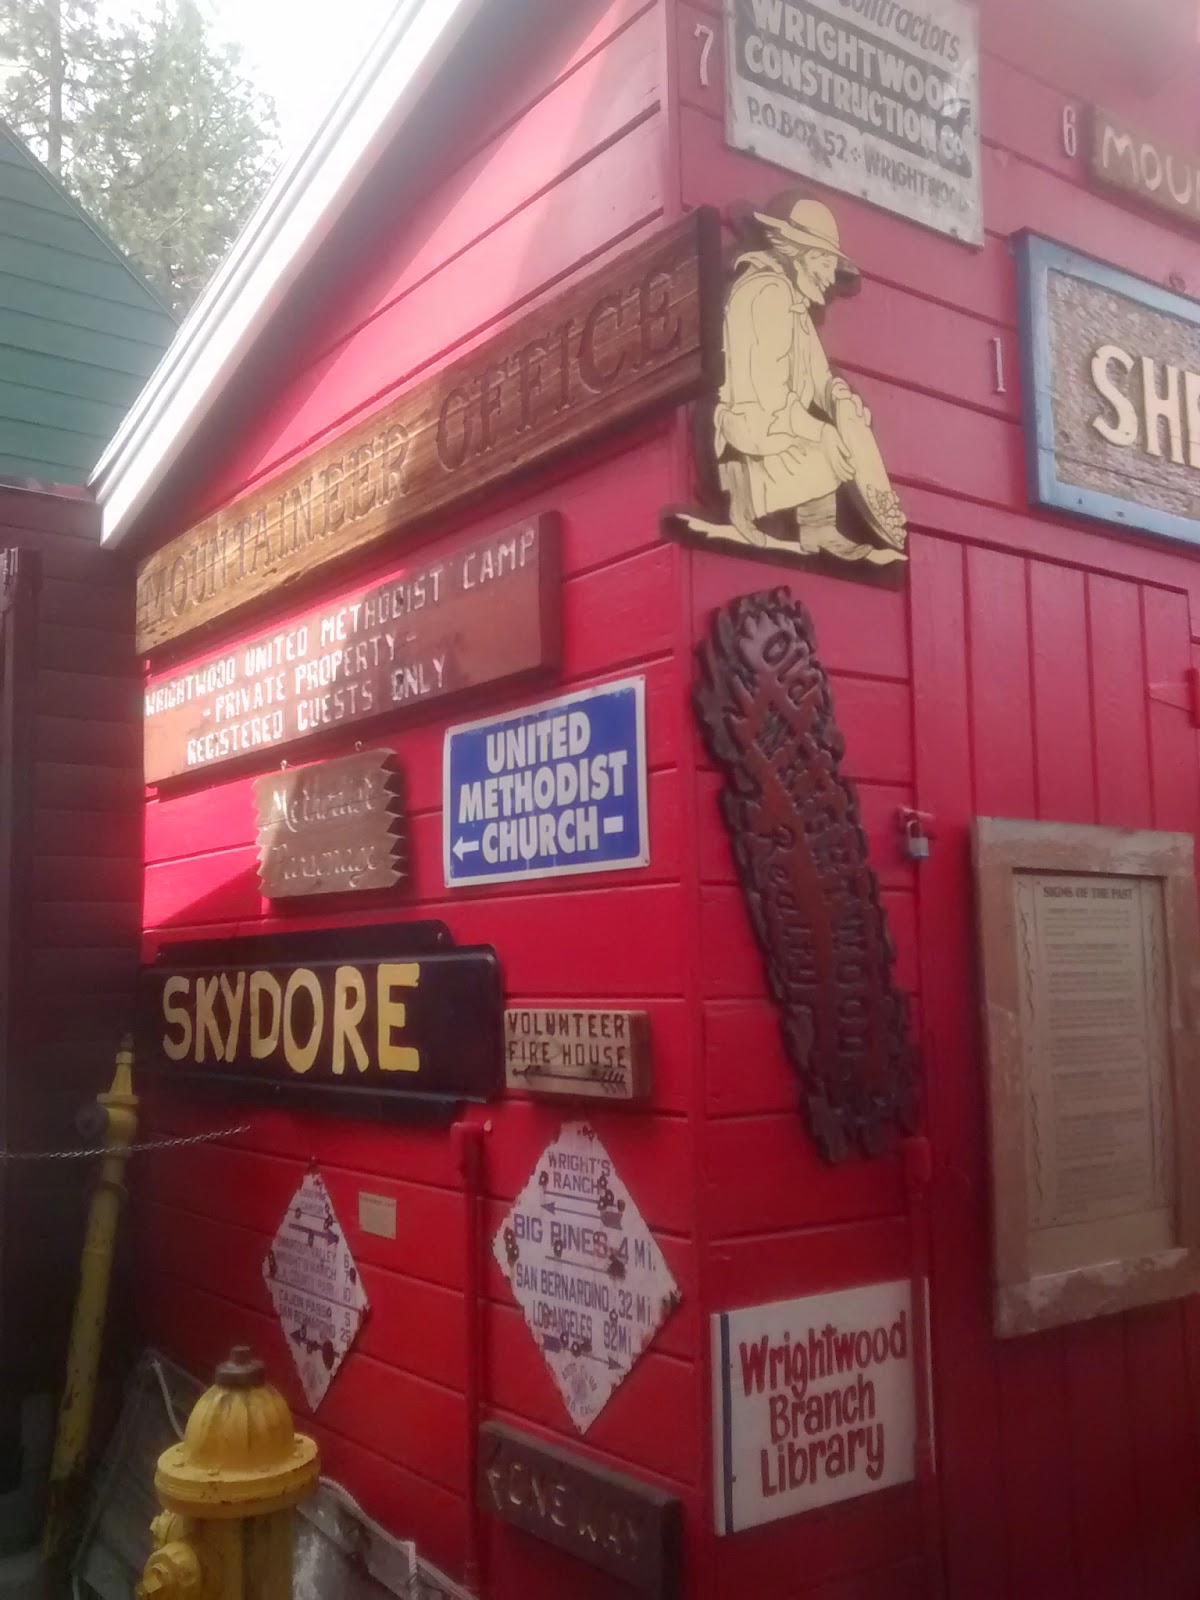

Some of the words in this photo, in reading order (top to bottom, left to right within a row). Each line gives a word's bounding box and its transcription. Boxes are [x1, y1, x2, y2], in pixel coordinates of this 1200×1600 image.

[694, 23, 714, 87] 7
[840, 0, 961, 63] ntractors
[744, 35, 937, 155] CONSTRUCTION
[1062, 104, 1078, 158] 6
[1102, 125, 1200, 209] MOU
[140, 422, 413, 624] MOUNTAINEER
[435, 270, 684, 472] OFFICE
[245, 626, 308, 677] UNITED
[321, 568, 444, 648] METHODIST
[462, 529, 537, 591] CAMP
[187, 709, 284, 767] REGISTERED
[392, 653, 448, 702] ONLY
[486, 710, 591, 774] UNITED
[458, 750, 628, 824] METHODIST
[482, 806, 599, 864] CHURCH
[162, 962, 421, 1075] SKYDORE
[507, 1011, 625, 1039] VOLUNTEER
[508, 1039, 551, 1065] FIRE
[562, 1045, 627, 1069] HOUSE
[549, 1151, 611, 1177] WRIGHT'S
[553, 1171, 601, 1195] RANCH
[514, 1213, 543, 1244] BIG
[550, 1222, 609, 1260] PINES
[516, 1262, 538, 1293] SAN
[541, 1270, 610, 1314] BERNARDINO
[618, 1288, 633, 1321] 32
[739, 1309, 907, 1399] Wrightwood
[769, 1372, 876, 1446] Branch
[760, 1422, 885, 1498] Library
